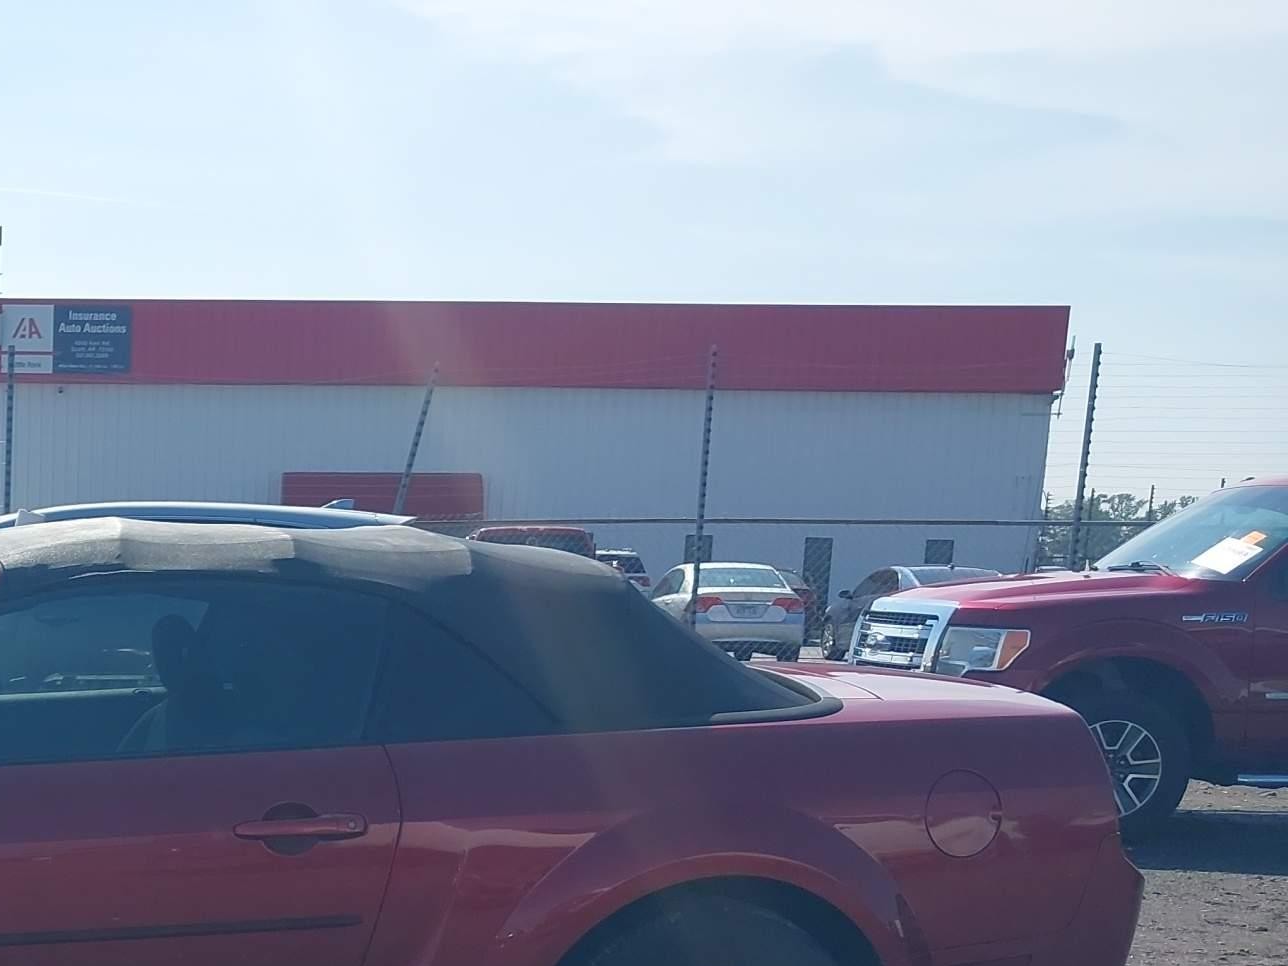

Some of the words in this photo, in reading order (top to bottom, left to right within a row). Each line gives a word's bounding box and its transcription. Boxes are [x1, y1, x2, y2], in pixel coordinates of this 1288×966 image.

[68, 310, 117, 321] Insurance
[58, 322, 82, 333] Auto
[83, 322, 128, 334] Auctions
